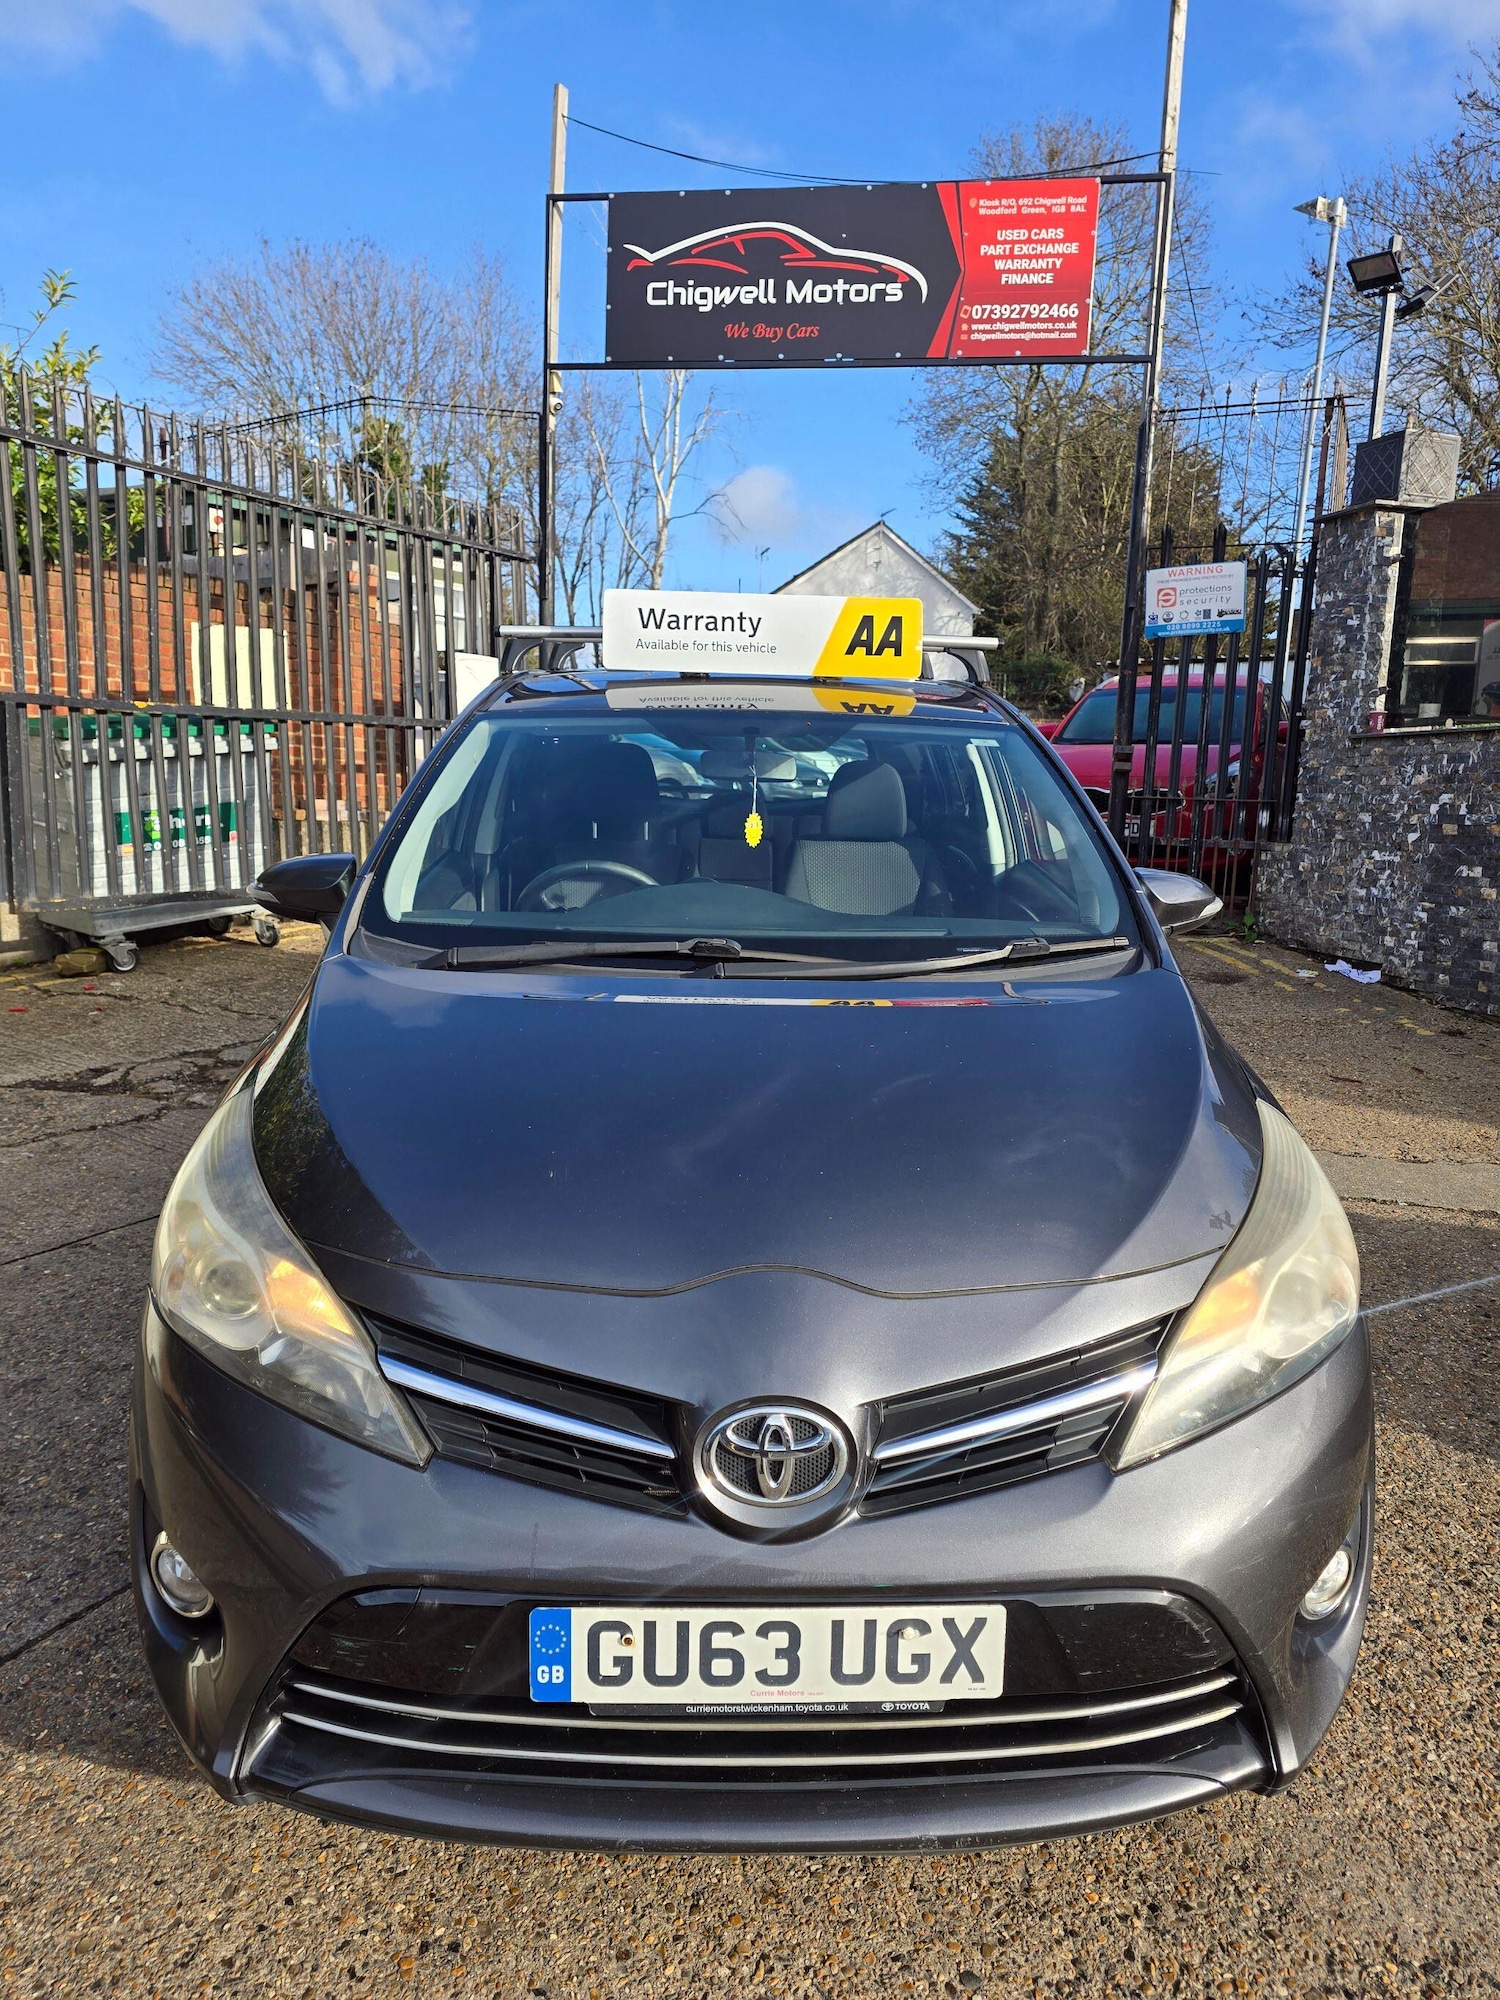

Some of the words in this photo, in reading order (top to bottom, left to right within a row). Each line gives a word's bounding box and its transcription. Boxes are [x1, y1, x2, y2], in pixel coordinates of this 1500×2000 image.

[979, 199, 1000, 207] Kiosk
[1034, 197, 1066, 206] Chigwell
[1068, 196, 1087, 204] Road
[979, 206, 1017, 215] Woodford
[1022, 206, 1047, 214] Green,
[997, 230, 1028, 240] USED
[1030, 228, 1064, 240] CARS
[980, 244, 1012, 256] PART
[1014, 242, 1079, 254] EXCHANGE
[994, 258, 1063, 270] WARRANTY
[1001, 273, 1054, 284] FINANCE
[646, 279, 776, 312] Chigwell
[786, 279, 903, 304] Motors
[972, 304, 1078, 319] 07392792466
[724, 322, 750, 338] We
[752, 323, 783, 342] Buy
[786, 322, 820, 338] Cars
[970, 322, 1078, 333] www.chigwellmotors.co.uk
[970, 332, 1077, 342] chigwellmotors@hotmail.com
[1168, 565, 1223, 577] WARNING
[1180, 584, 1232, 596] protections
[1180, 596, 1231, 606] security
[638, 607, 762, 638] Warranty
[844, 615, 903, 657] AA
[636, 638, 689, 651] Available
[692, 640, 708, 652] for
[712, 641, 733, 652] this
[736, 642, 777, 654] vehicle
[587, 1620, 802, 1688] GU63
[830, 1617, 988, 1687] UGX
[536, 1666, 564, 1684] GB
[686, 1703, 849, 1713] curriemotorstwickenham.toyota.co.uk
